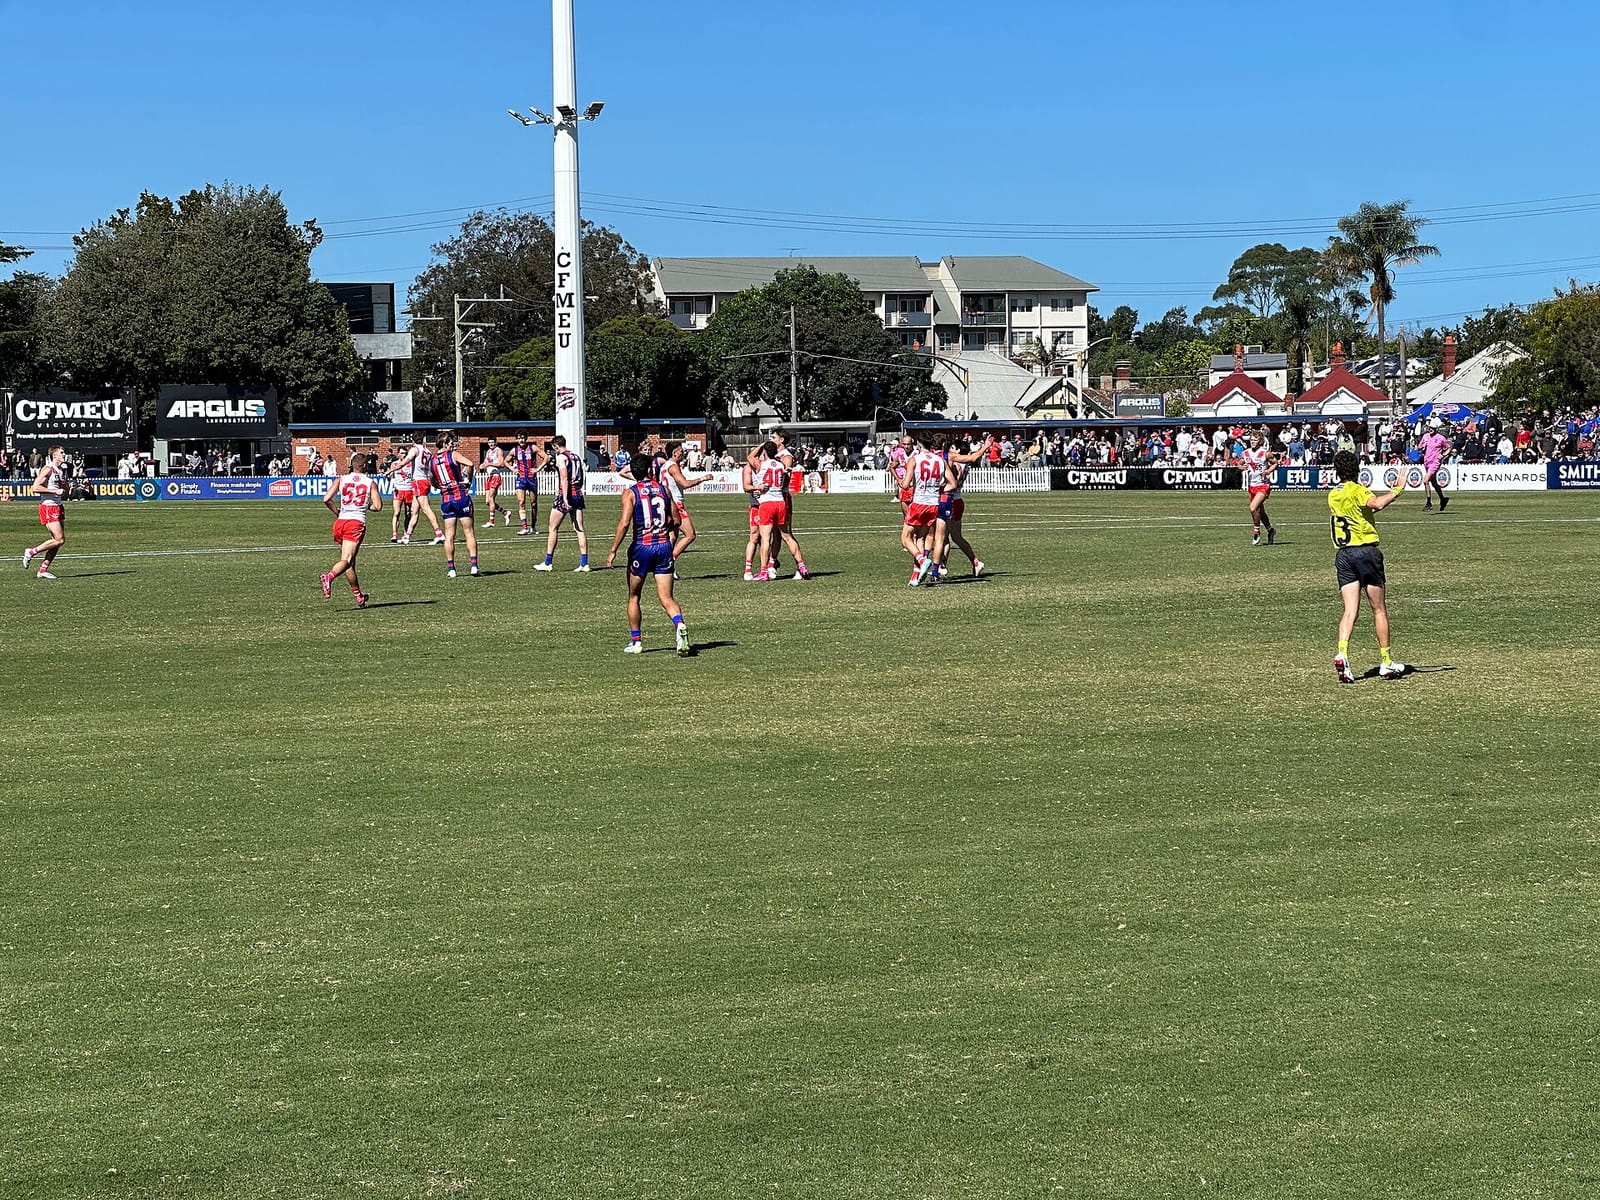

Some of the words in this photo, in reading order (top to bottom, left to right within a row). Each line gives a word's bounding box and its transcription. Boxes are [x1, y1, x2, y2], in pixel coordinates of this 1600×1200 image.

[556, 252, 574, 348] CFMEU
[15, 398, 122, 421] CFMEU
[166, 399, 266, 418] ARGUS
[1119, 398, 1160, 406] ARGUS
[437, 464, 451, 485] 11
[762, 468, 784, 487] 40
[851, 473, 875, 481] instinct
[920, 460, 940, 482] 64
[1067, 470, 1127, 485] CFMEU
[1163, 469, 1223, 484] CFMEU
[1287, 469, 1310, 484] ETU
[1472, 473, 1547, 482] STANNARDS
[16, 485, 41, 497] LIK
[101, 484, 136, 496] BUCKS
[342, 483, 368, 507] 59
[641, 496, 666, 528] 13
[1331, 515, 1351, 547] 13
